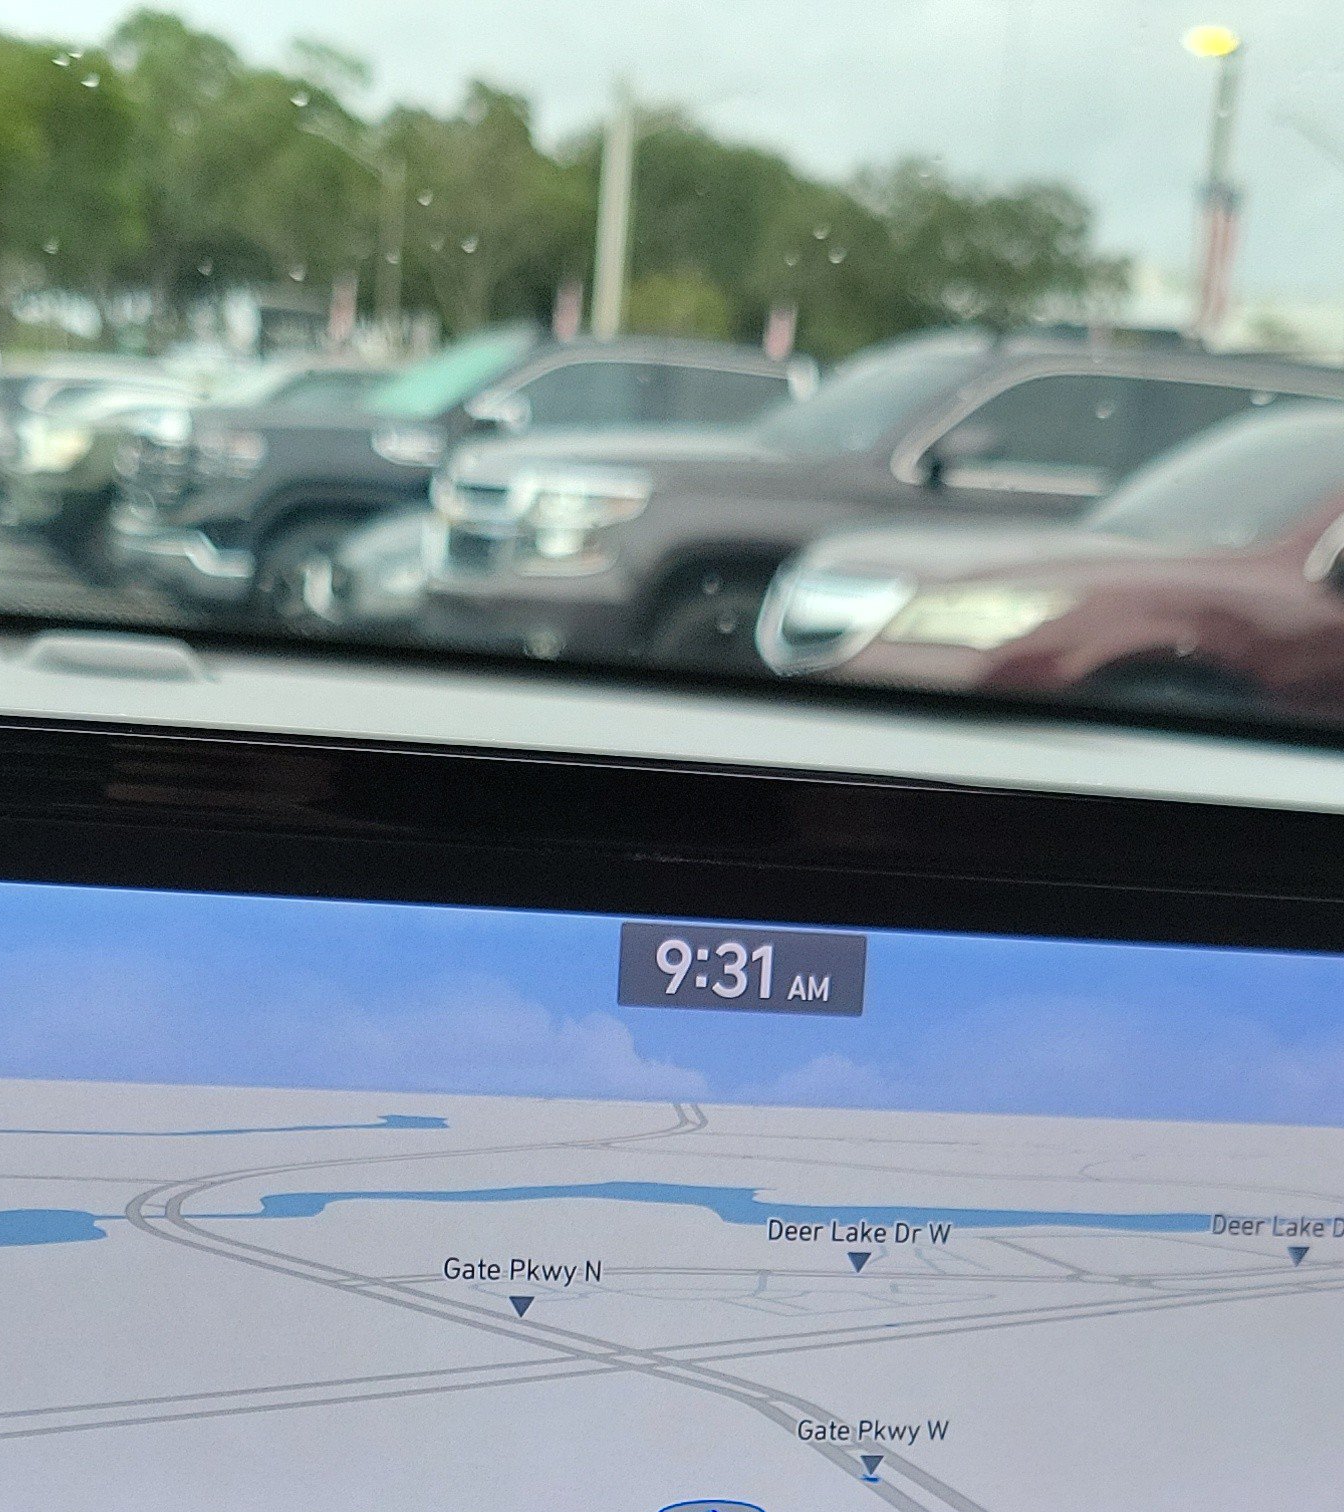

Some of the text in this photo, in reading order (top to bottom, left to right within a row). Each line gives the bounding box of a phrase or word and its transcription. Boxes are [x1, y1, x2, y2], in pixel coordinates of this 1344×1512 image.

[655, 939, 830, 1002] 9:31 AM
[768, 1220, 952, 1245] Deer Lake Dr W
[1212, 1213, 1264, 1236] Deer
[1272, 1214, 1325, 1238] Lake
[443, 1257, 603, 1287] Gate Pkwy N
[797, 1419, 950, 1446] Gate Pkwy W
